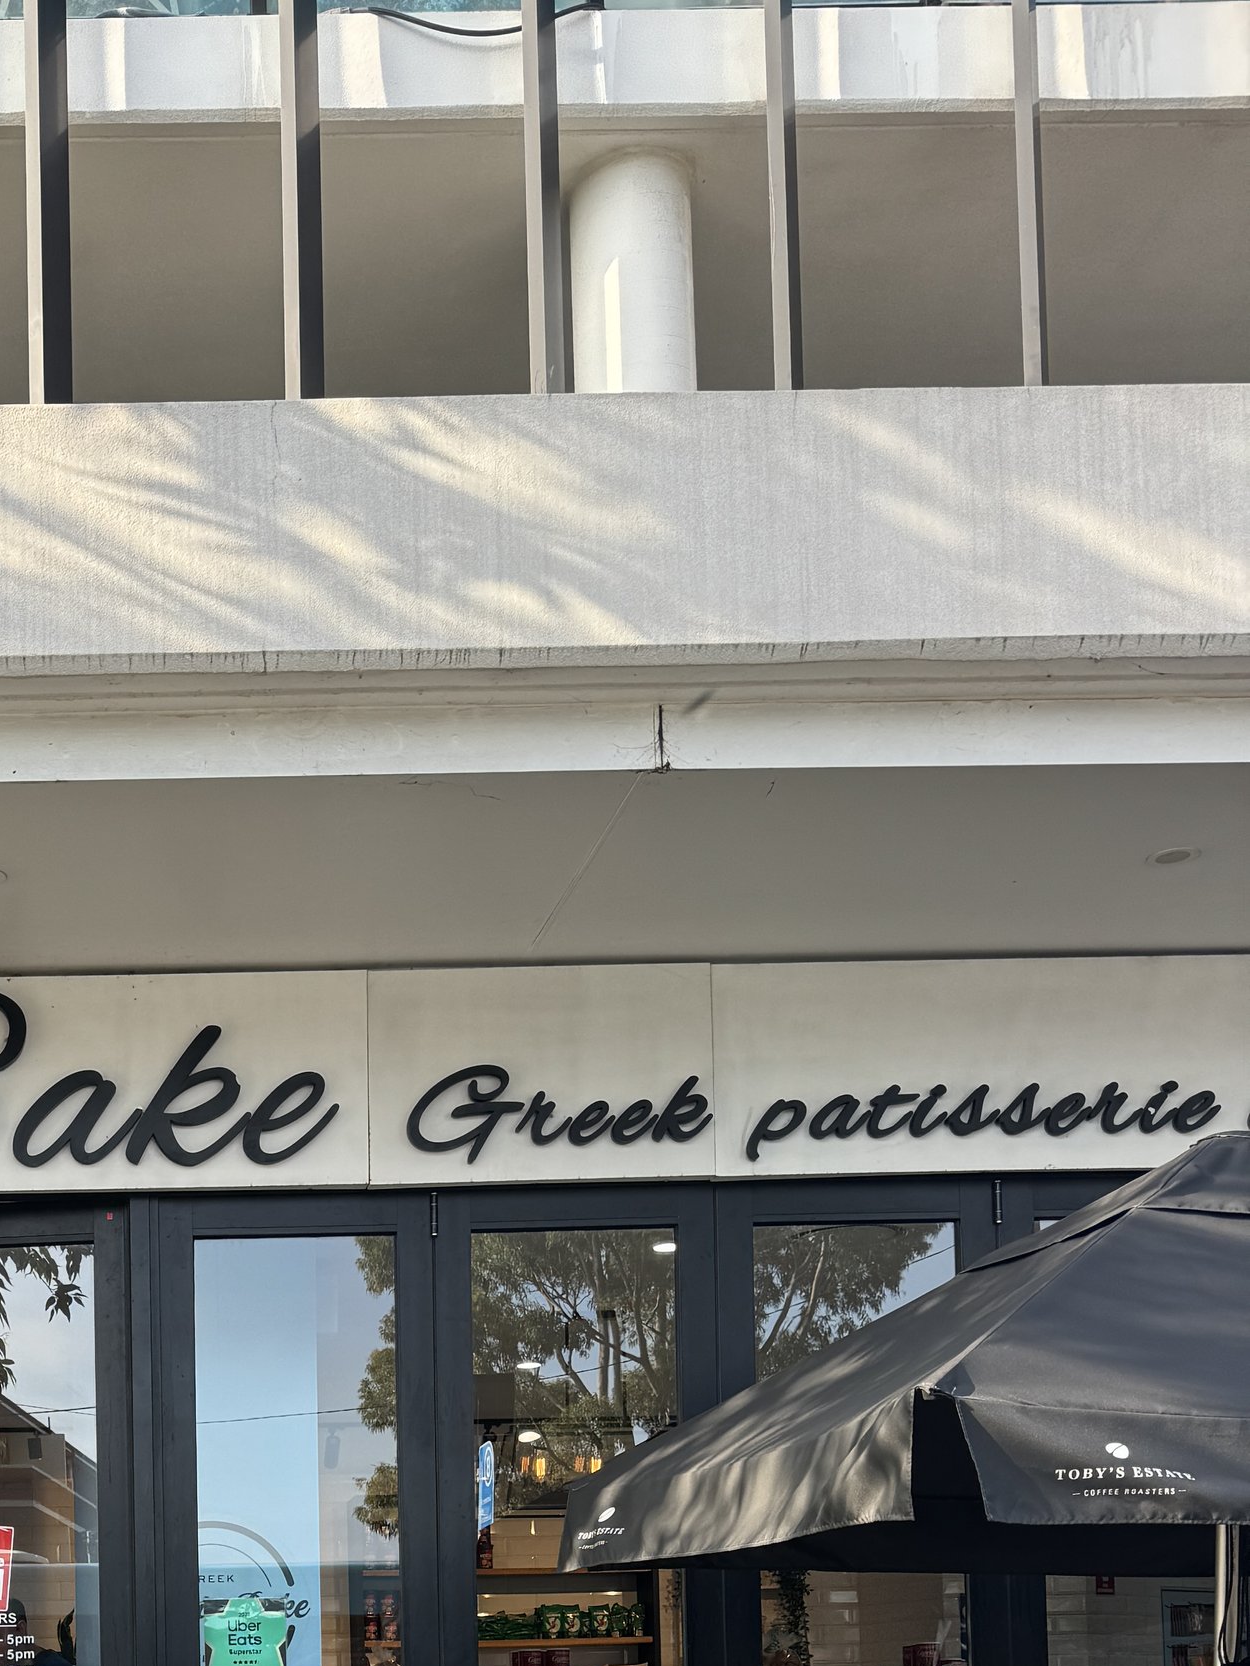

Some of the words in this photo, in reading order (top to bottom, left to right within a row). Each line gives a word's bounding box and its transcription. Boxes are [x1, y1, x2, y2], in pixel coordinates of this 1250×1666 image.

[406, 1064, 713, 1165] Greek
[745, 1080, 1221, 1162] patisserie
[1055, 1466, 1125, 1480] TOBY'S
[1084, 1488, 1119, 1496] COFFEE
[198, 1575, 235, 1583] REEK
[228, 1620, 261, 1632] Uber
[7, 1634, 34, 1647] 5pm
[228, 1634, 262, 1646] Eats
[7, 1649, 35, 1662] 5pm
